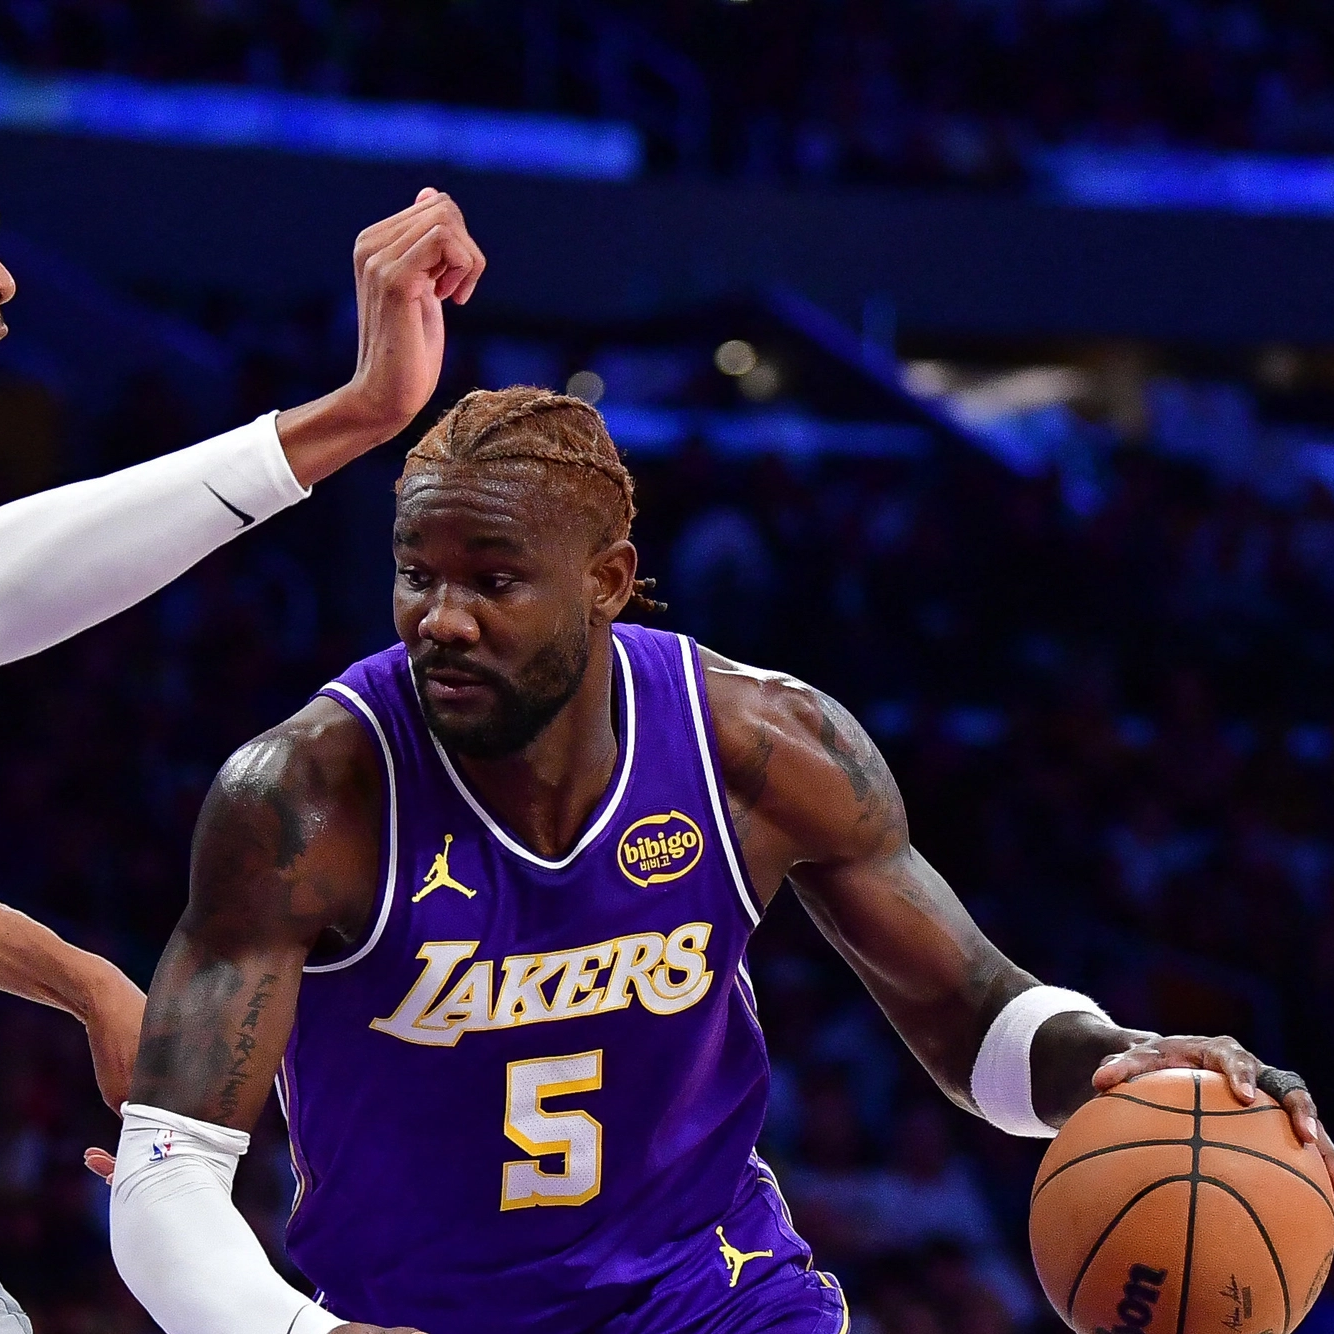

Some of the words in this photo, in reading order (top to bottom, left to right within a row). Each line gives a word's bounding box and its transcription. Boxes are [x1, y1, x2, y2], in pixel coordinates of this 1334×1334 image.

[623, 831, 697, 864] bibigo
[639, 854, 672, 872] 비비고
[369, 922, 714, 1047] LAKERS
[500, 1049, 603, 1212] 5
